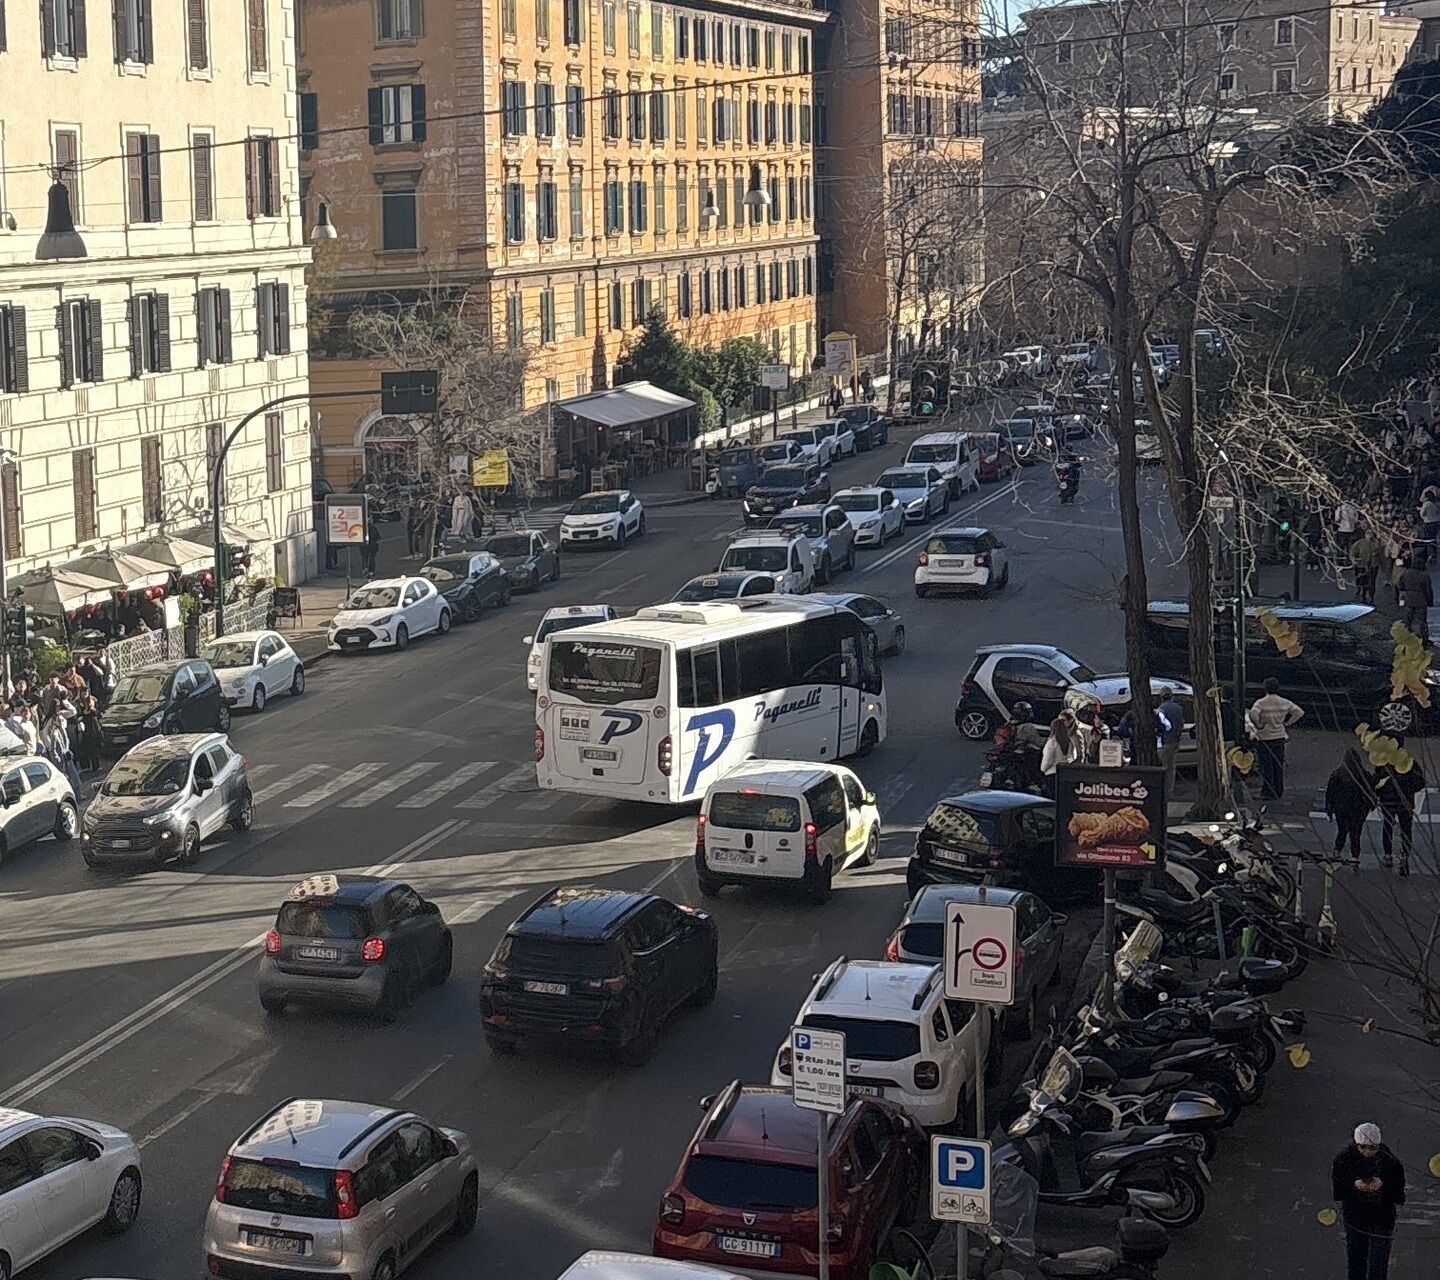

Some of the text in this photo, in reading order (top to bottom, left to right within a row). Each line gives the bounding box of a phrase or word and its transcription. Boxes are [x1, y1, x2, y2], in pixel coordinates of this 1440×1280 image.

[572, 642, 638, 657] Paganelli
[754, 686, 822, 723] Paganelli
[1074, 782, 1130, 797] Jollibee
[799, 1035, 808, 1048] P
[948, 1149, 975, 1181] P
